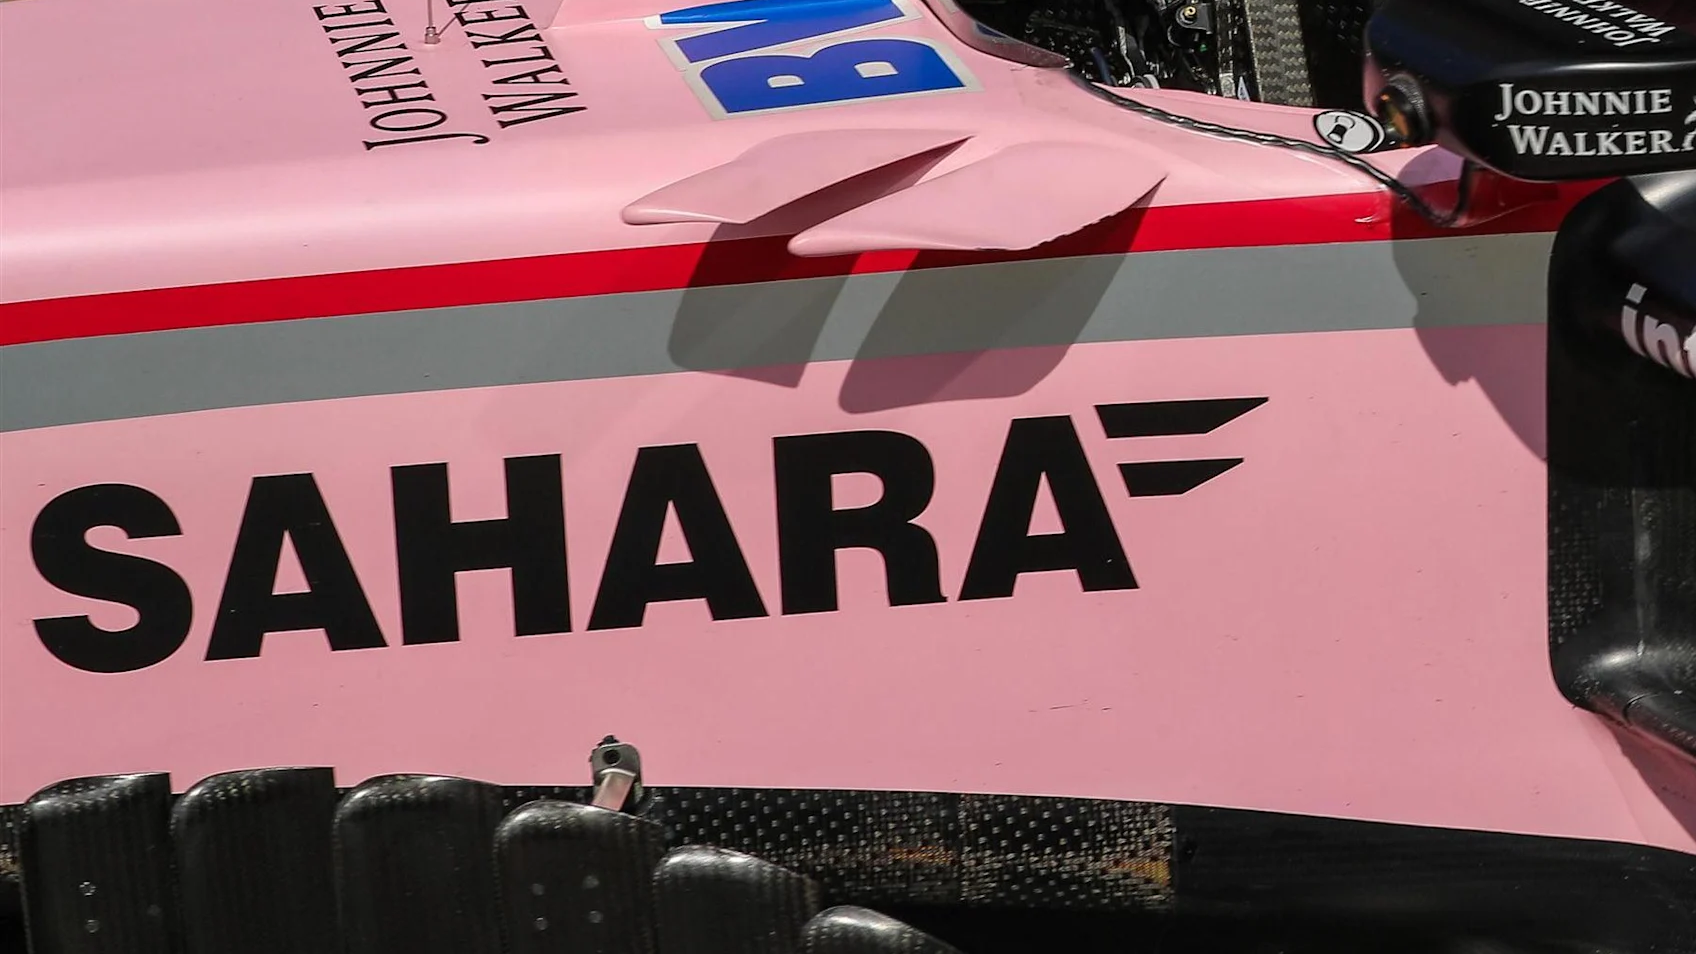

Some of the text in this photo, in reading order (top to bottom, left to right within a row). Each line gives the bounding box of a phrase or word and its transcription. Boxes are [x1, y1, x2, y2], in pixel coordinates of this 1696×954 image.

[1494, 83, 1673, 121] JOHNNIE
[1507, 125, 1680, 156] WALKER
[31, 415, 1139, 674] SAHARA
